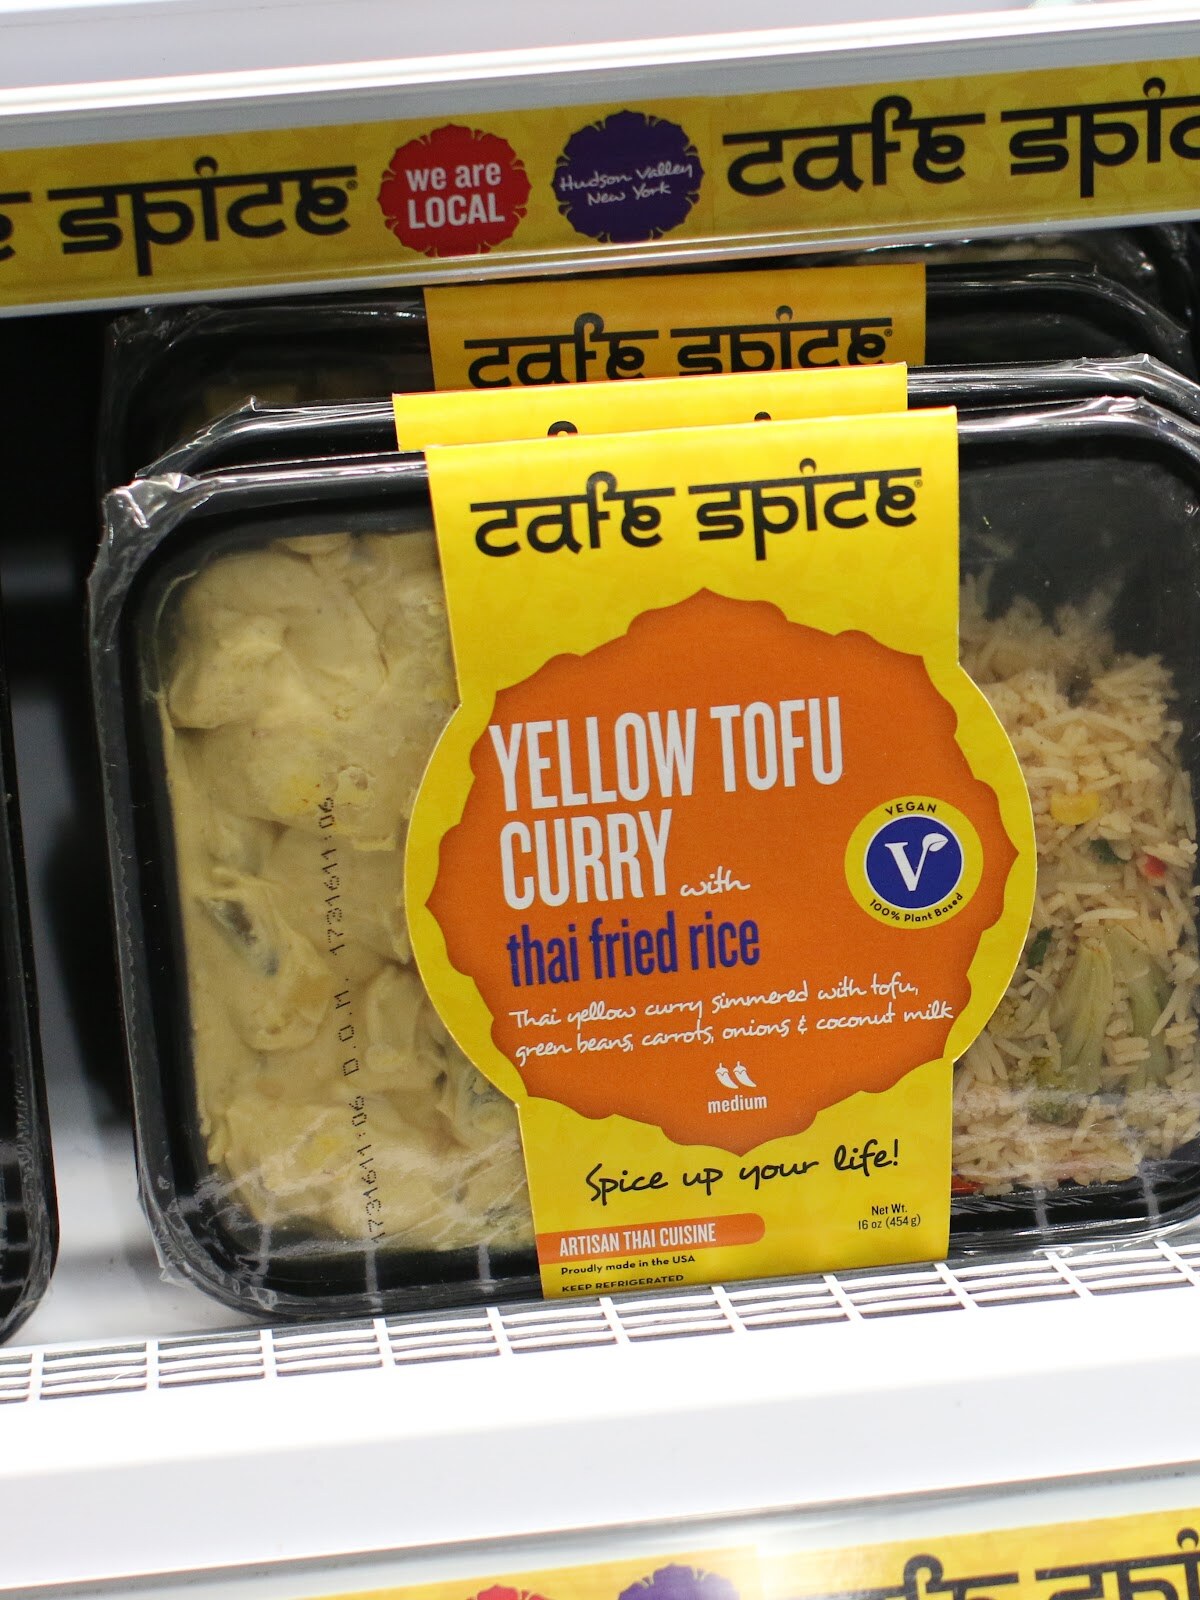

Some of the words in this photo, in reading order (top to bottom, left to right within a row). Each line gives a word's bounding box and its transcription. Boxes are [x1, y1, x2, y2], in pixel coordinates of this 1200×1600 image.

[723, 96, 985, 196] cafe
[405, 167, 447, 192] we
[454, 162, 502, 189] are
[559, 171, 632, 193] Hudson
[636, 161, 694, 183] Valley
[587, 192, 626, 206] New
[632, 182, 672, 199] York
[407, 192, 506, 230] LOCAL
[464, 312, 658, 390] cafe
[470, 471, 675, 558] cafe
[488, 707, 697, 813] YELLOW
[709, 695, 845, 793] TOFU
[885, 801, 938, 816] VEGAN
[500, 808, 673, 911] CURRY
[680, 865, 751, 898] with
[869, 898, 901, 921] 100%
[904, 912, 933, 922] Plant
[934, 892, 964, 917] Based
[506, 922, 581, 988] thai
[589, 910, 679, 980] fried
[688, 910, 761, 971] rice
[509, 1008, 561, 1030] Thai
[566, 1000, 637, 1031] yellow
[644, 999, 704, 1020] curry
[711, 980, 809, 1014] simmered
[818, 976, 868, 1001] with
[870, 971, 919, 998] tofu,
[515, 1040, 573, 1068] green
[576, 1032, 635, 1055] beans,
[641, 1022, 715, 1048] carrots,
[721, 1016, 791, 1042] onions
[796, 1014, 808, 1036] &
[816, 1009, 898, 1032] coconut
[903, 999, 955, 1022] milk
[707, 1093, 768, 1114] medium
[585, 1162, 669, 1207] Spice
[682, 1167, 725, 1196] up
[738, 1160, 820, 1191] your
[833, 1138, 900, 1177] life!
[858, 1219, 869, 1230] 16
[871, 1220, 882, 1229] oz
[871, 1205, 888, 1216] Net
[891, 1203, 908, 1214] Wt.
[559, 1232, 620, 1257] ARTISAN
[623, 1228, 656, 1250] THAI
[659, 1222, 717, 1248] CUISINE
[561, 1262, 603, 1276] Proudly
[605, 1259, 636, 1271] made
[638, 1259, 649, 1268] in
[651, 1256, 670, 1267] the
[672, 1254, 696, 1265] USA
[561, 1283, 593, 1292] KEEP
[595, 1273, 685, 1290] REFRIGERATED
